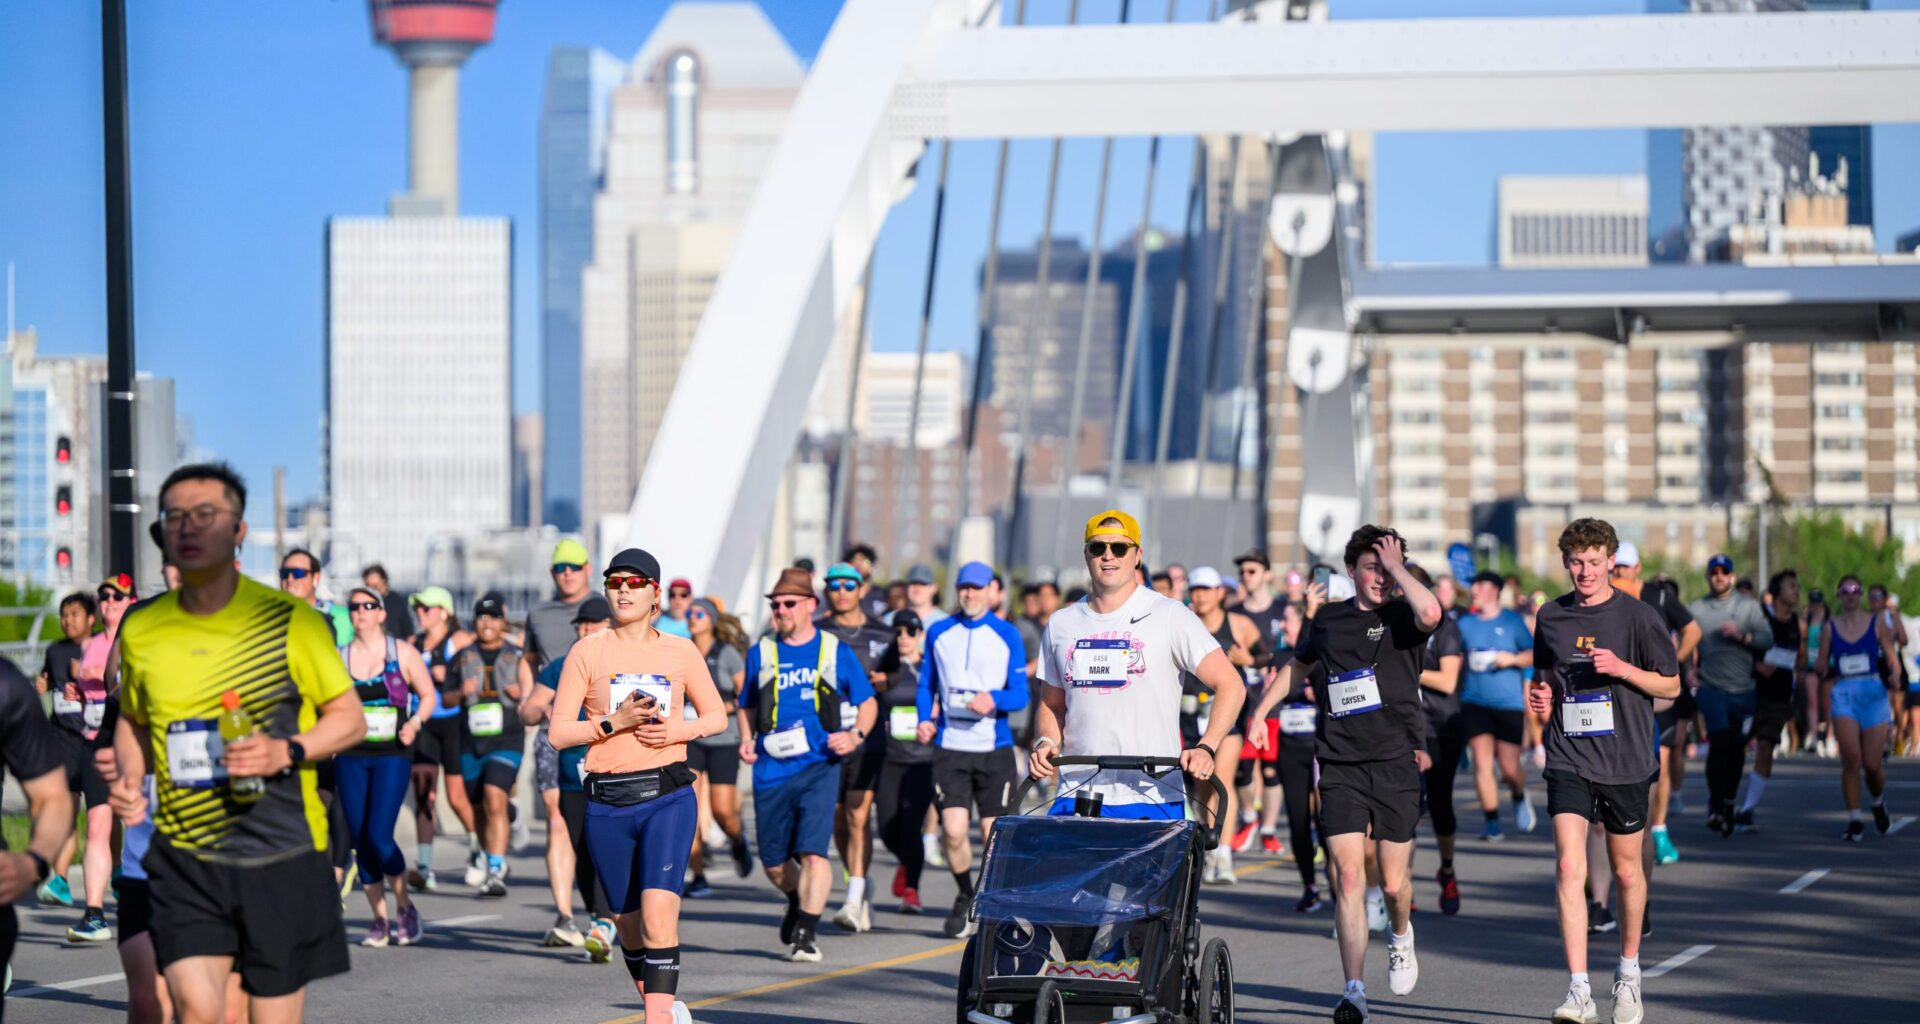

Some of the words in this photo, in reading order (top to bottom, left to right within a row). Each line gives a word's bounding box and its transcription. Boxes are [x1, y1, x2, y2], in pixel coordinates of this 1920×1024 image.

[1089, 666, 1110, 675] MARK
[1341, 694, 1366, 705] CAYSEN
[1581, 718, 1592, 726] ELI
